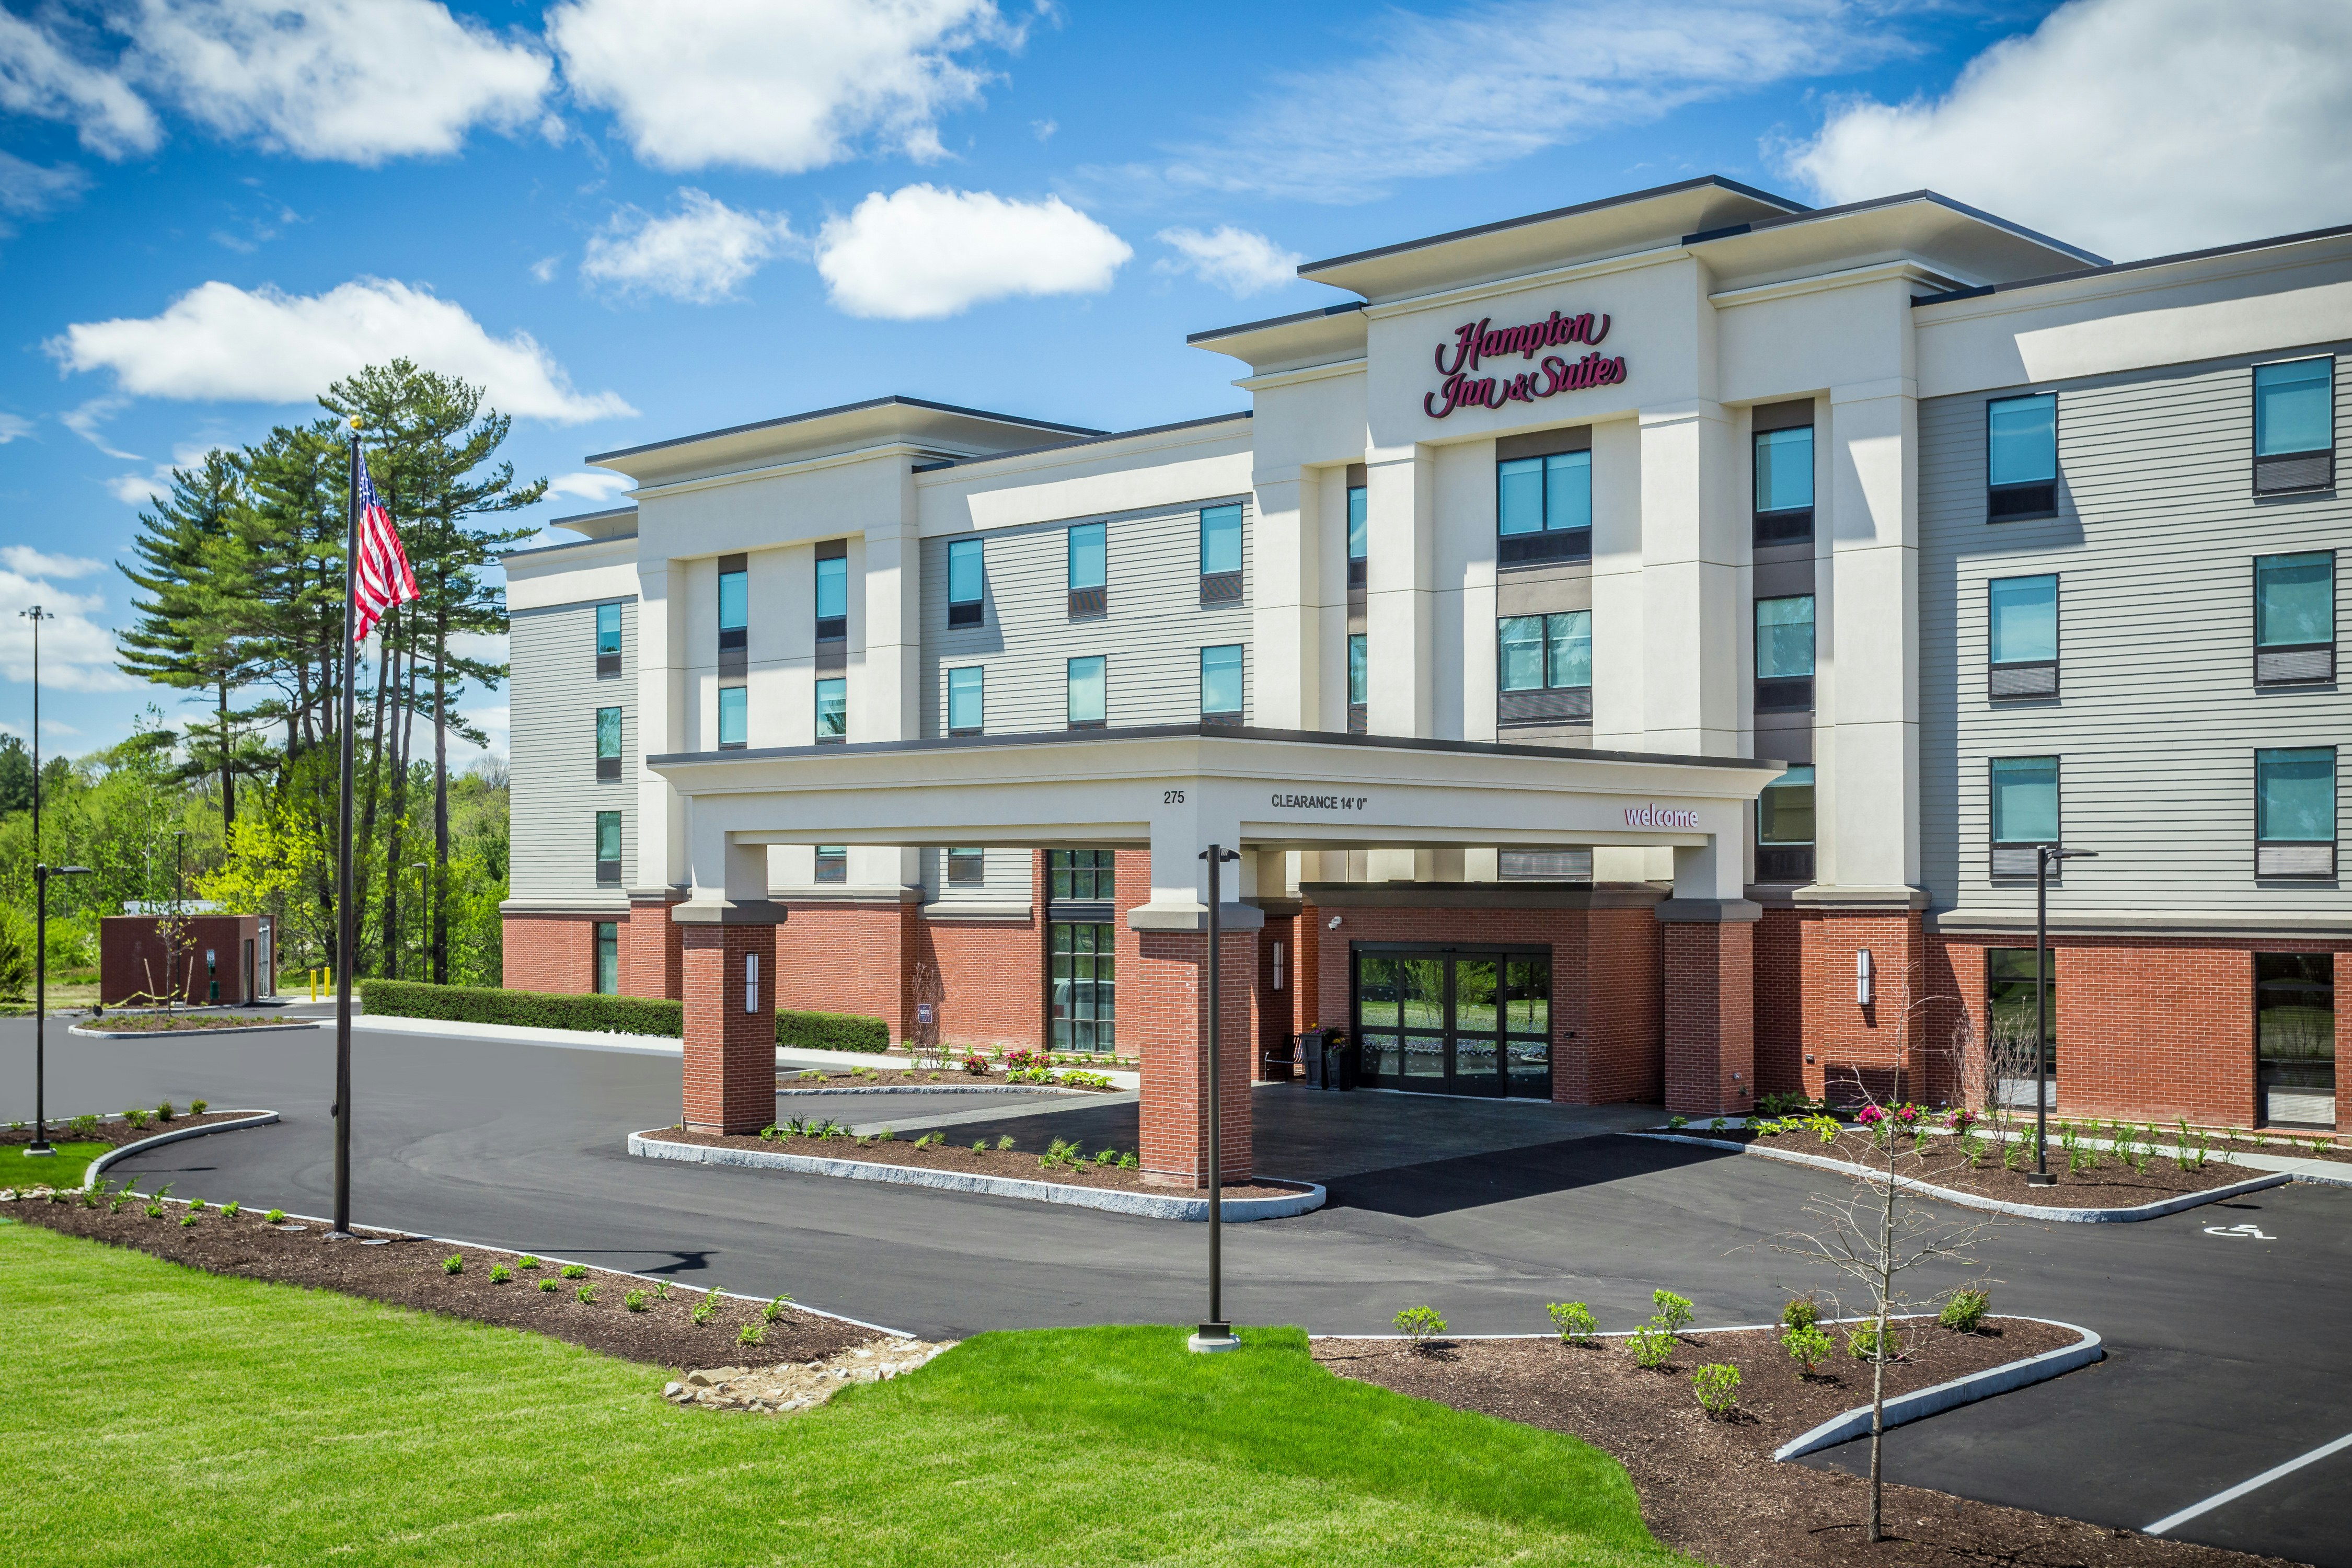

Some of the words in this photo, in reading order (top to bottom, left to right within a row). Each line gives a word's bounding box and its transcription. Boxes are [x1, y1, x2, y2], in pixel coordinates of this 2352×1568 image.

[1435, 310, 1610, 375] Hampton
[1424, 372, 1510, 418] Inn
[1508, 373, 1534, 402] &
[1528, 351, 1627, 398] Suites
[1163, 790, 1185, 804] 275
[1271, 794, 1338, 809] CLEARANCE
[1340, 797, 1355, 810] 14'
[1357, 798, 1368, 810] 0"
[1624, 803, 1699, 827] welcome
